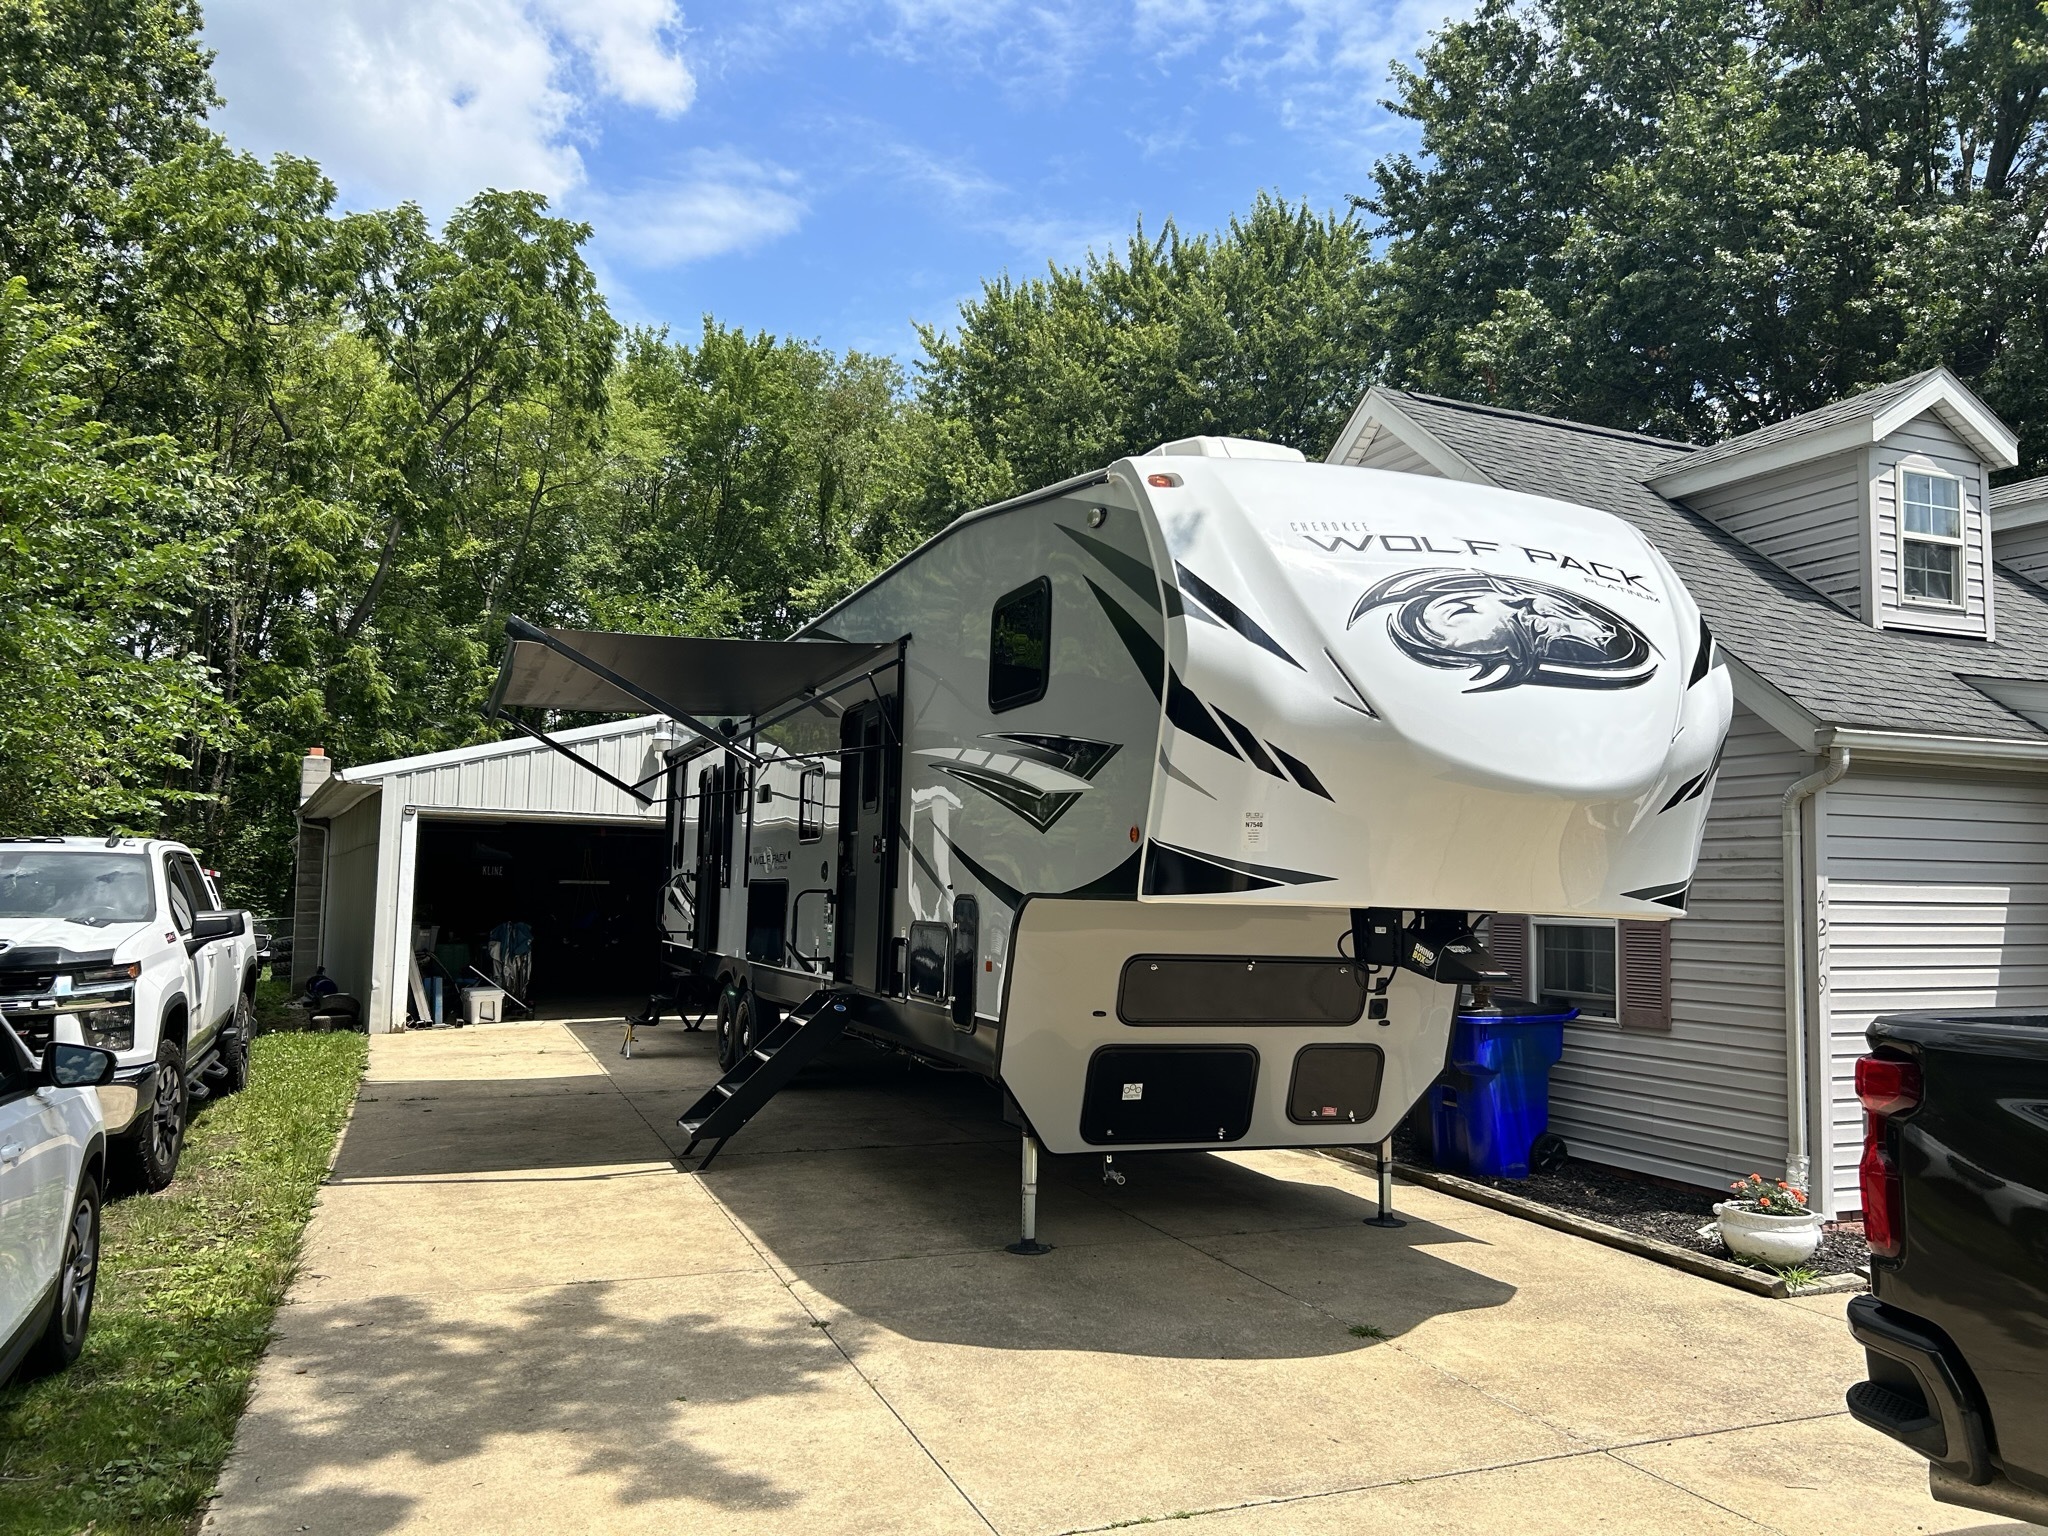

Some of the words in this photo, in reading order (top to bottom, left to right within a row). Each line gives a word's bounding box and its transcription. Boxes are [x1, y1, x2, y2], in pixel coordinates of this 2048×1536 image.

[1290, 522, 1370, 532] CHEROKEE
[1300, 534, 1499, 556] WOLF
[1518, 546, 1654, 593] PACK
[1583, 577, 1661, 604] PLATINUM
[1412, 950, 1426, 964] BOX
[1415, 943, 1434, 960] RHINO
